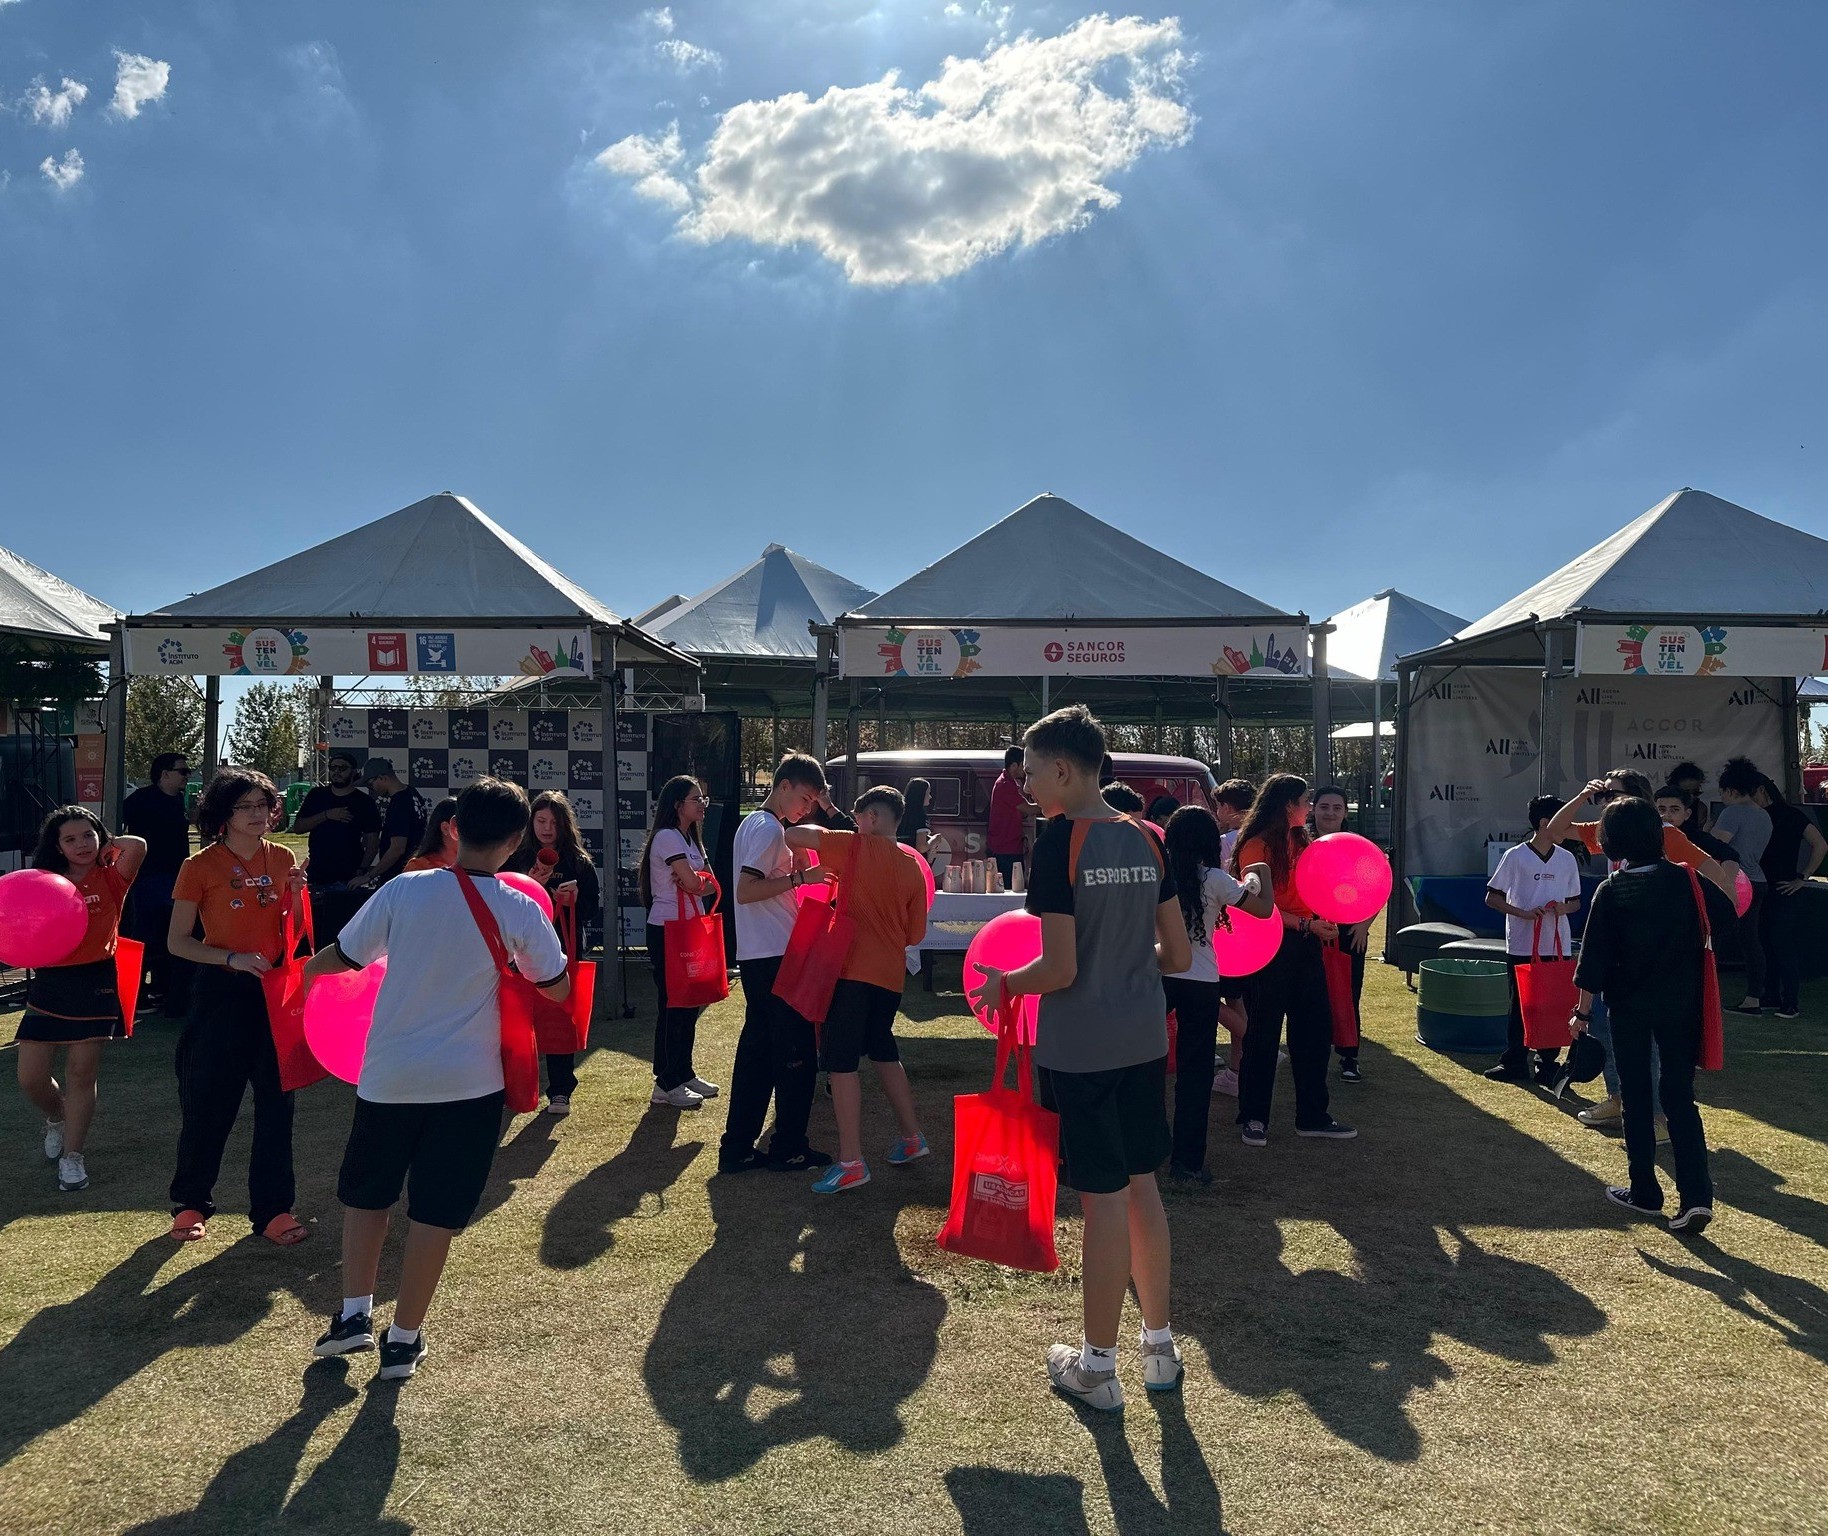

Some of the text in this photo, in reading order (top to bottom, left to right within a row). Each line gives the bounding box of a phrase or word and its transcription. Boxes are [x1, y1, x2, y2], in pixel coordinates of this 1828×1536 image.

[371, 636, 376, 645] 4
[419, 636, 427, 645] 16
[917, 639, 942, 647] SUS
[1659, 635, 1686, 644] SUS
[917, 647, 942, 655] TEN
[1067, 642, 1125, 651] SANCOR
[1659, 644, 1685, 653] TEN
[1067, 653, 1126, 663] SEGUROS
[256, 660, 278, 668] VEL
[917, 663, 942, 671] VEL
[1658, 661, 1684, 670] VEL
[1627, 718, 1705, 733] ACCOR
[1083, 865, 1157, 887] ESPORTES
